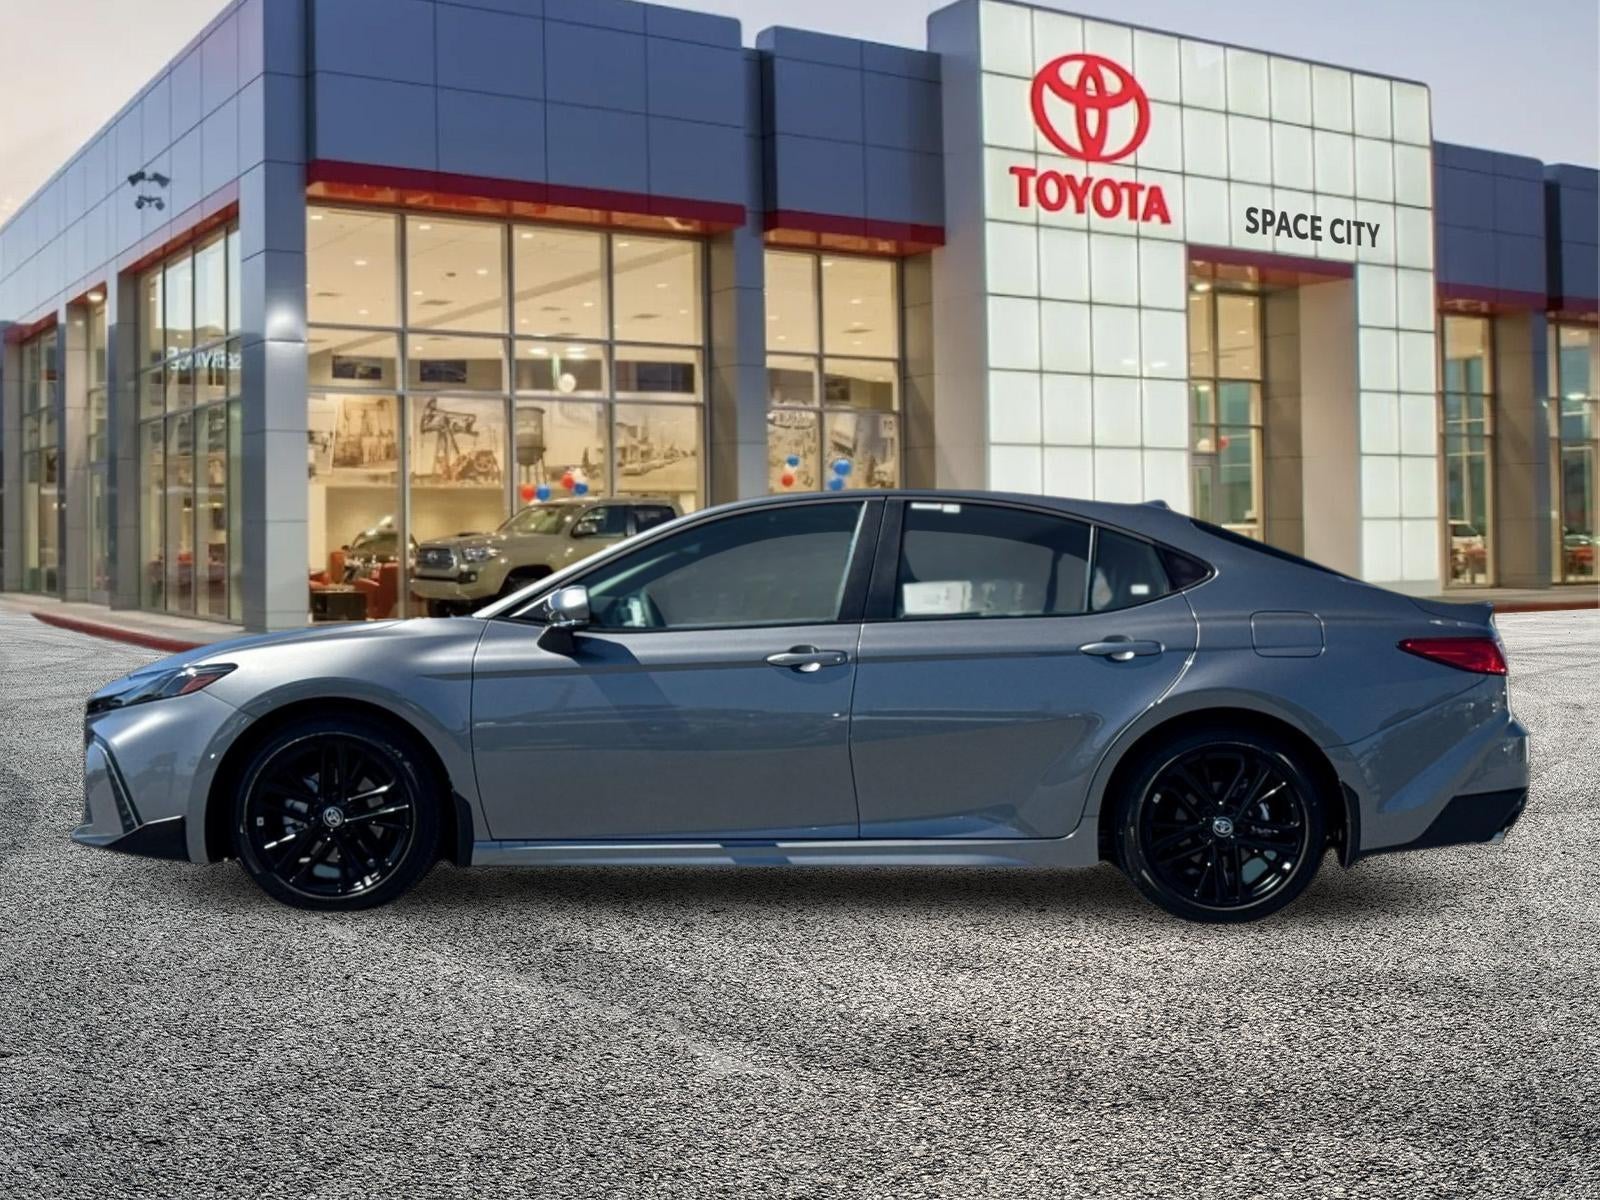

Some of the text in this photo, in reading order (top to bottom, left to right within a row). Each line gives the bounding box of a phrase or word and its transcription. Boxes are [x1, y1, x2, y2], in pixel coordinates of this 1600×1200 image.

[1009, 166, 1171, 224] TOYOTA
[1245, 206, 1380, 248] SPACE CITY
